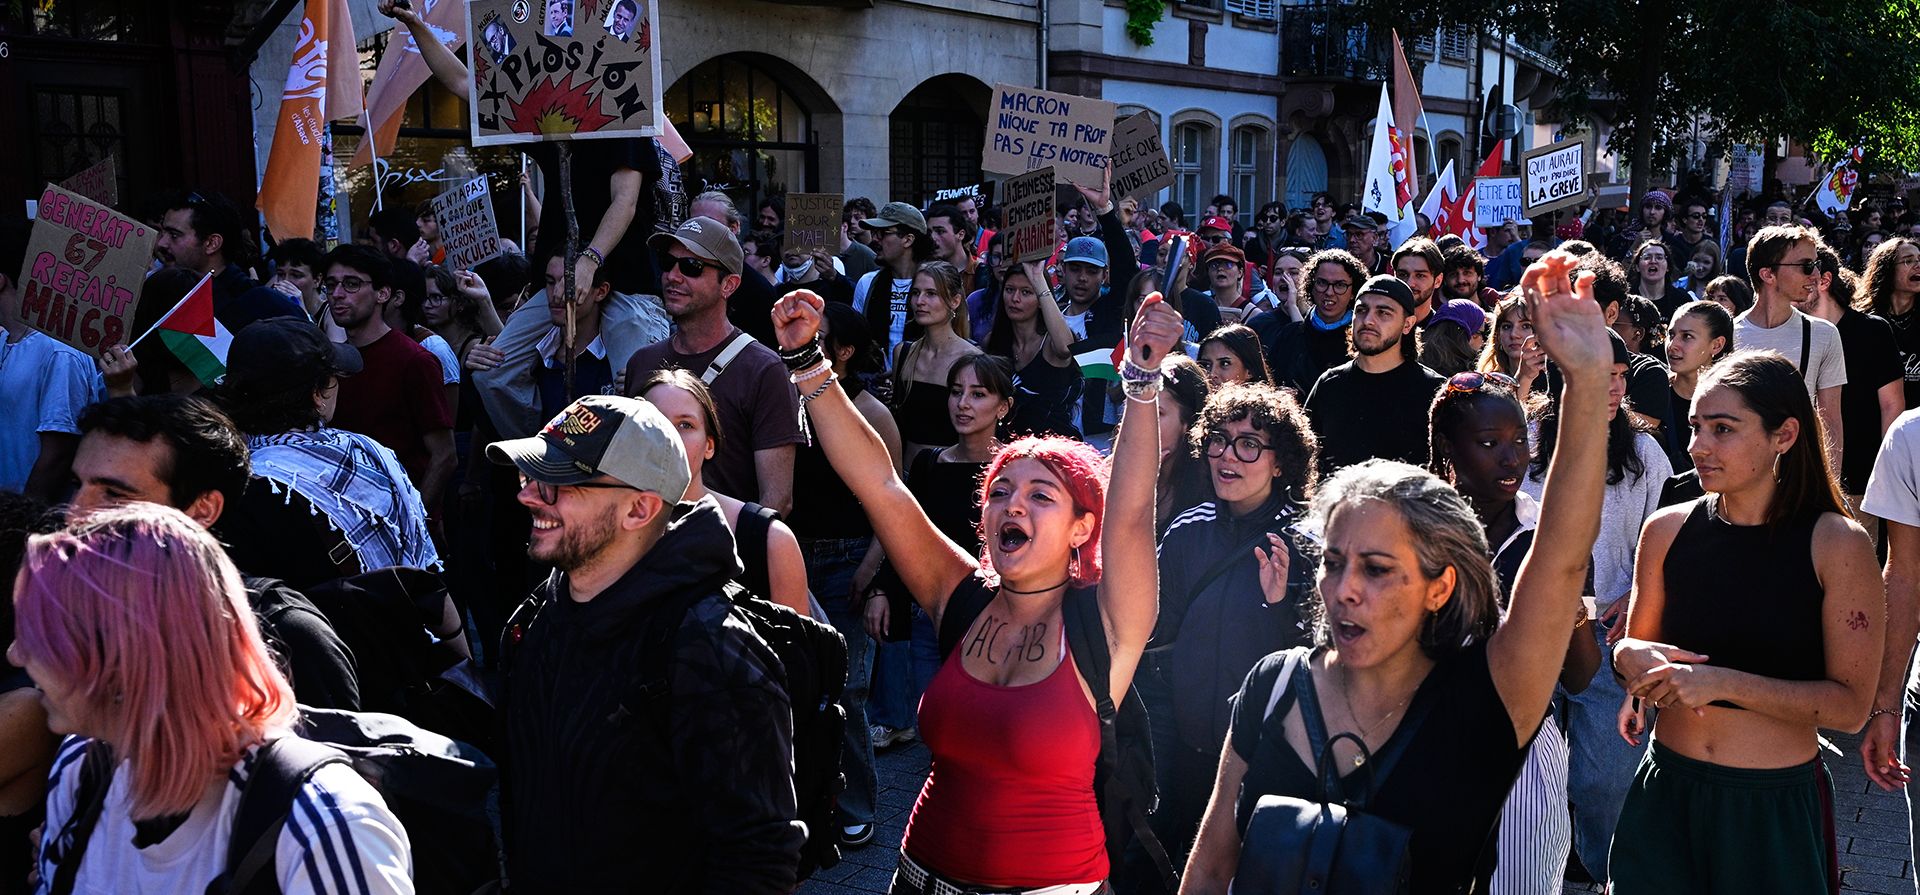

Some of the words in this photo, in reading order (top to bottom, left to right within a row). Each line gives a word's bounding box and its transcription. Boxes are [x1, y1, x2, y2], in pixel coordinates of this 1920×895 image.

[1000, 91, 1070, 116] MACRON
[1048, 121, 1068, 138] TA
[1074, 124, 1107, 145] PROF
[993, 133, 1025, 155] PAS
[1030, 140, 1057, 159] LES
[1059, 147, 1108, 170] NOTRES
[1136, 135, 1161, 157] QUE
[1529, 159, 1546, 176] QUI
[1549, 149, 1581, 170] AURAIT
[465, 178, 484, 197] PAS
[1012, 172, 1056, 203] JEUNESSE
[1110, 158, 1169, 201] POUBELLES
[1478, 182, 1503, 200] ÊTRE
[465, 198, 485, 217] QUE
[791, 197, 841, 211] JUSTICE
[1530, 187, 1547, 204] LA
[798, 214, 829, 226] POUR
[1009, 195, 1052, 227] EMMERDE
[1478, 204, 1491, 216] PAS
[440, 230, 450, 242] LA
[450, 216, 479, 238] FRANCE
[64, 232, 108, 273] 67
[443, 230, 476, 255] MACRON
[452, 236, 499, 269] ENCULER
[1002, 231, 1015, 260] LE
[80, 307, 124, 352] 68
[965, 614, 1047, 664] ACAB
